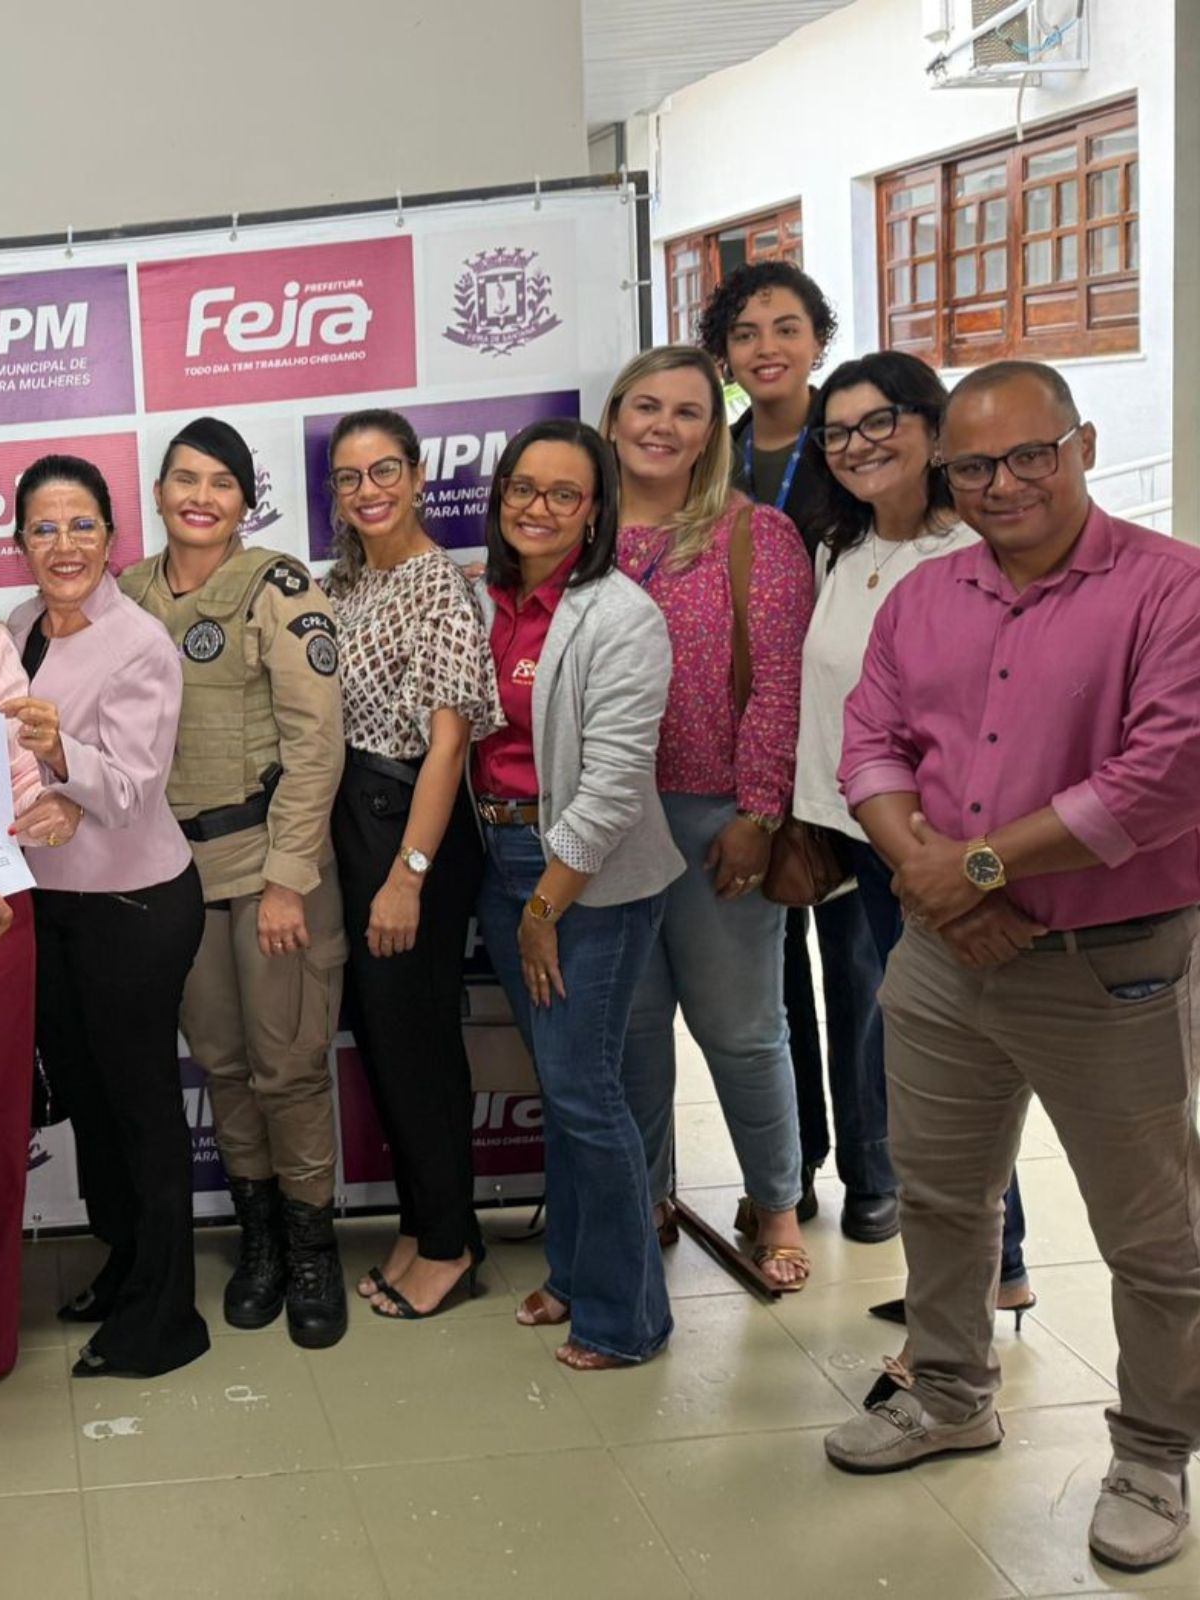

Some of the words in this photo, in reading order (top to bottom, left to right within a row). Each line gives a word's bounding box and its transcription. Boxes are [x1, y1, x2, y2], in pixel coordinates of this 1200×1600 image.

[304, 278, 364, 293] PREFEITURA
[185, 281, 373, 357] Feira
[69, 357, 88, 370] DE
[184, 366, 211, 377] TODO
[212, 364, 230, 375] DIA
[232, 361, 253, 373] TEM
[255, 356, 309, 370] TRABALHO
[310, 351, 367, 365] CHEGANDO
[19, 373, 91, 391] MULHERES
[439, 487, 490, 503] MUNICI
[425, 505, 461, 519] PARA
[193, 1151, 220, 1162] ARA
